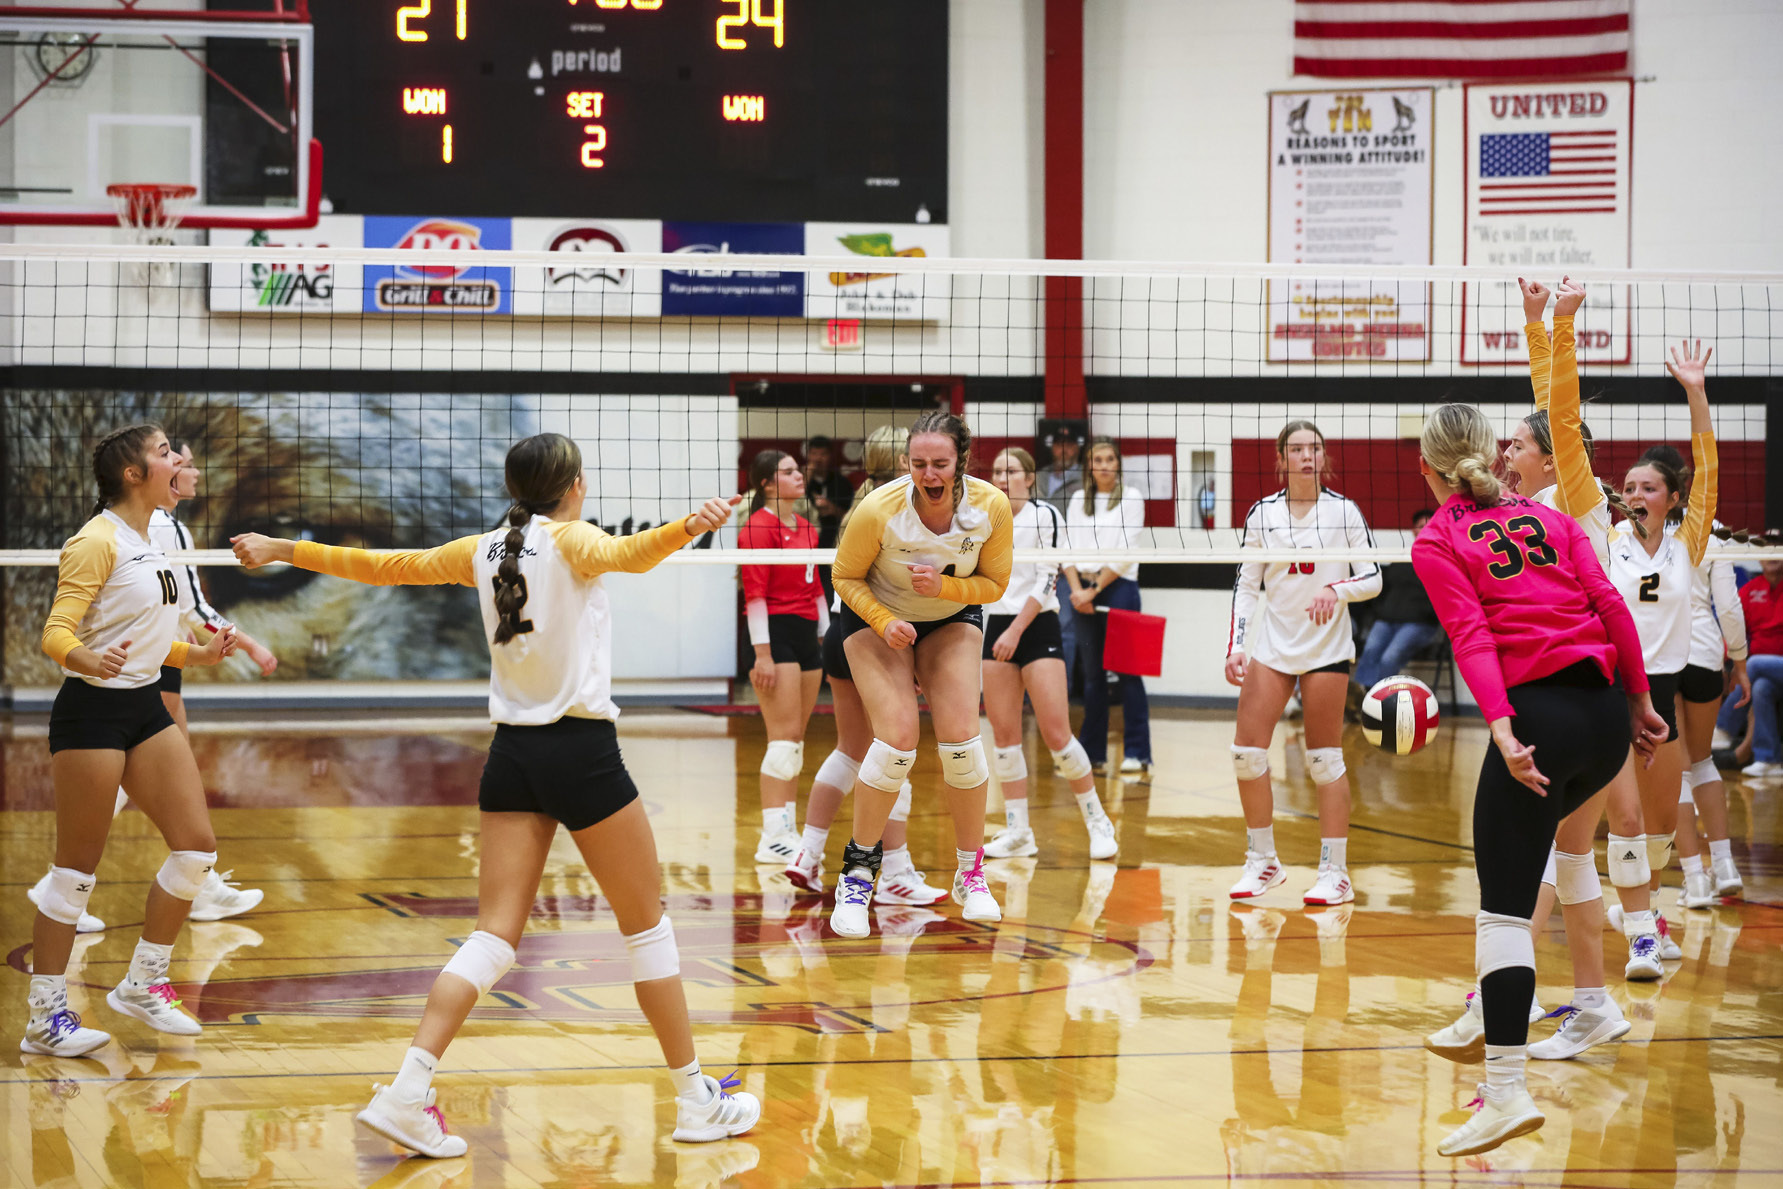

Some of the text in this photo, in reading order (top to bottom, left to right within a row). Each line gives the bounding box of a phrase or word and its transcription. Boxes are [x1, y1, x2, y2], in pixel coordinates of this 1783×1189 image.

[717, 0, 784, 50] 24
[551, 47, 621, 76] period
[567, 91, 604, 118] SET
[1489, 92, 1608, 119] UNITED
[443, 124, 452, 163] 1
[582, 125, 606, 168] 2
[1286, 134, 1416, 150] REASONS TO SPORT
[1278, 150, 1425, 166] A WINNING ATTITUDE!
[384, 285, 430, 304] Grill
[444, 286, 491, 305] Chill
[1482, 331, 1519, 350] WE
[1467, 514, 1559, 581] 33
[156, 569, 179, 606] 10
[1638, 572, 1661, 603] 2
